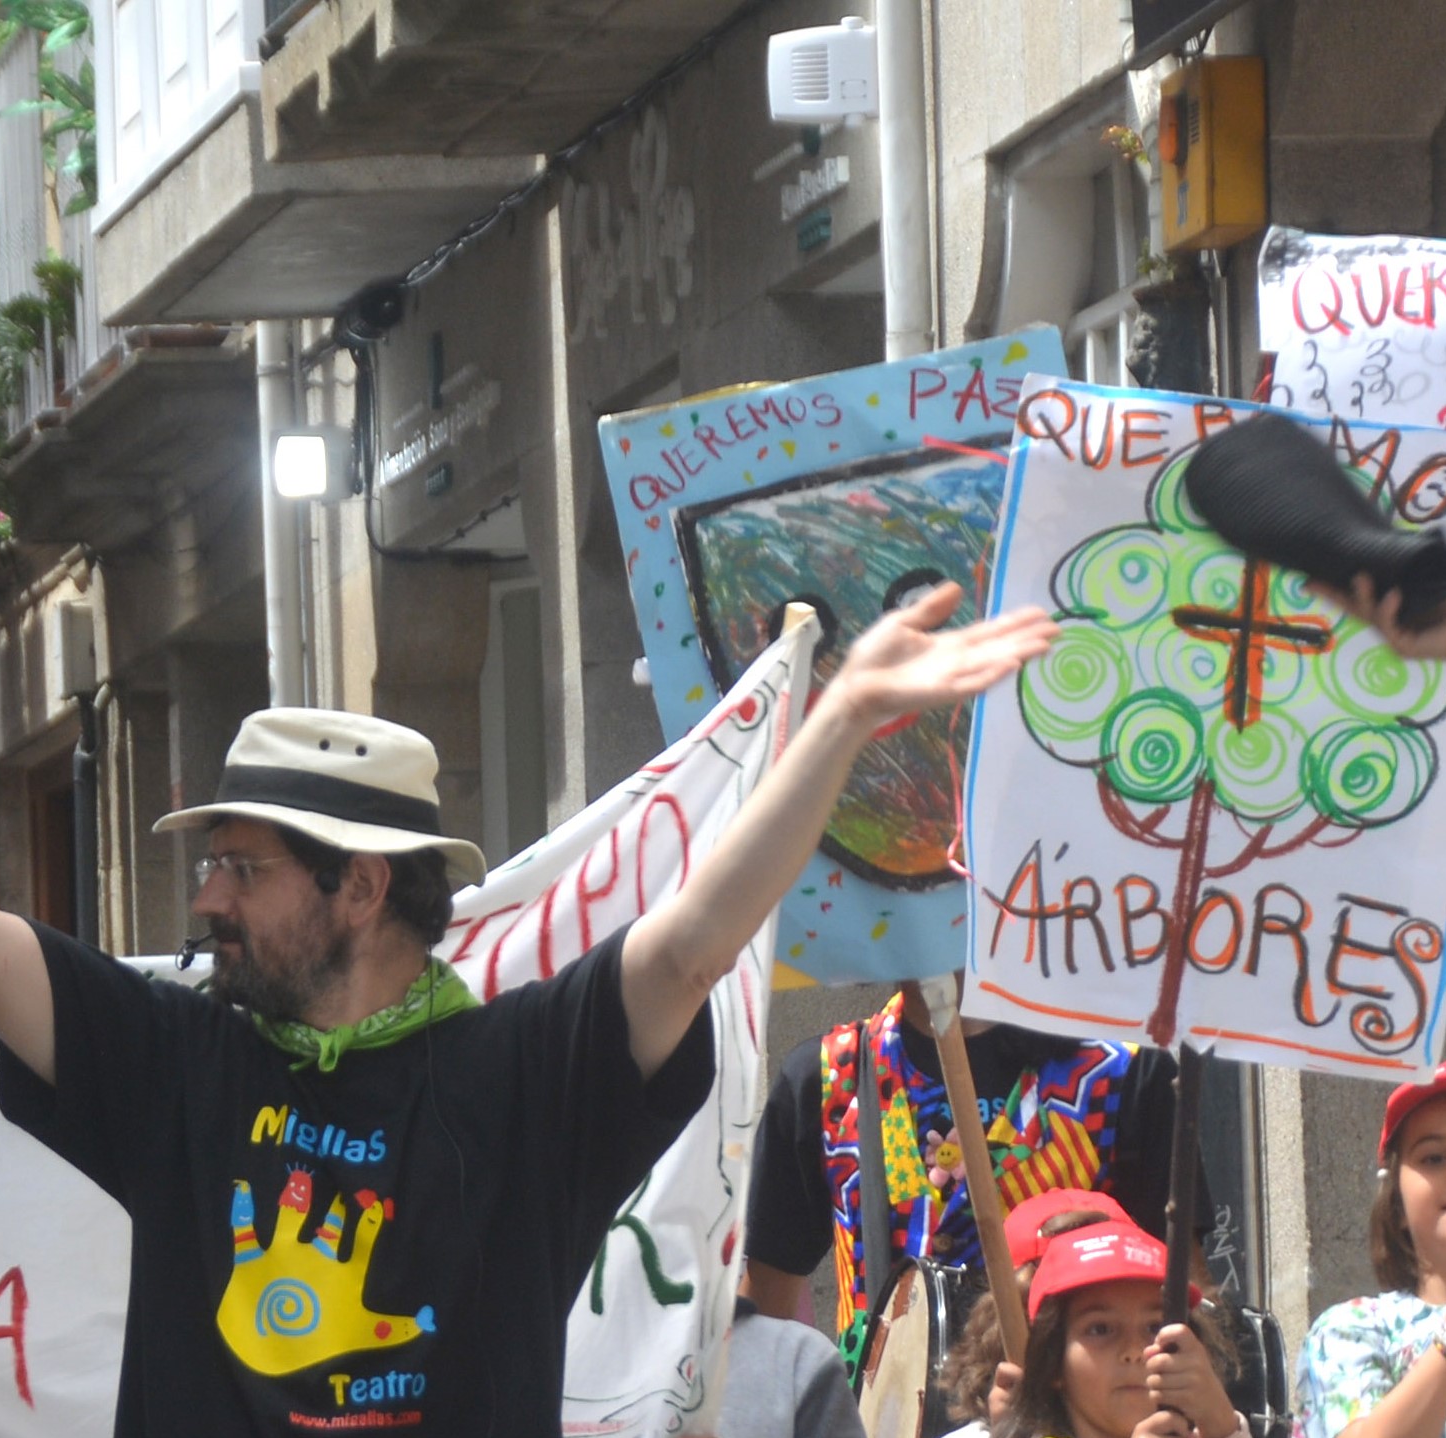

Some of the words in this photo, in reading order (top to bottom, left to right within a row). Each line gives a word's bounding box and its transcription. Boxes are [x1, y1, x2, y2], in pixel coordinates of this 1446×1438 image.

[629, 393, 844, 511] QUEREMOS
[982, 835, 1443, 1055] ÁRBORES
[328, 1370, 426, 1406] Teatro
